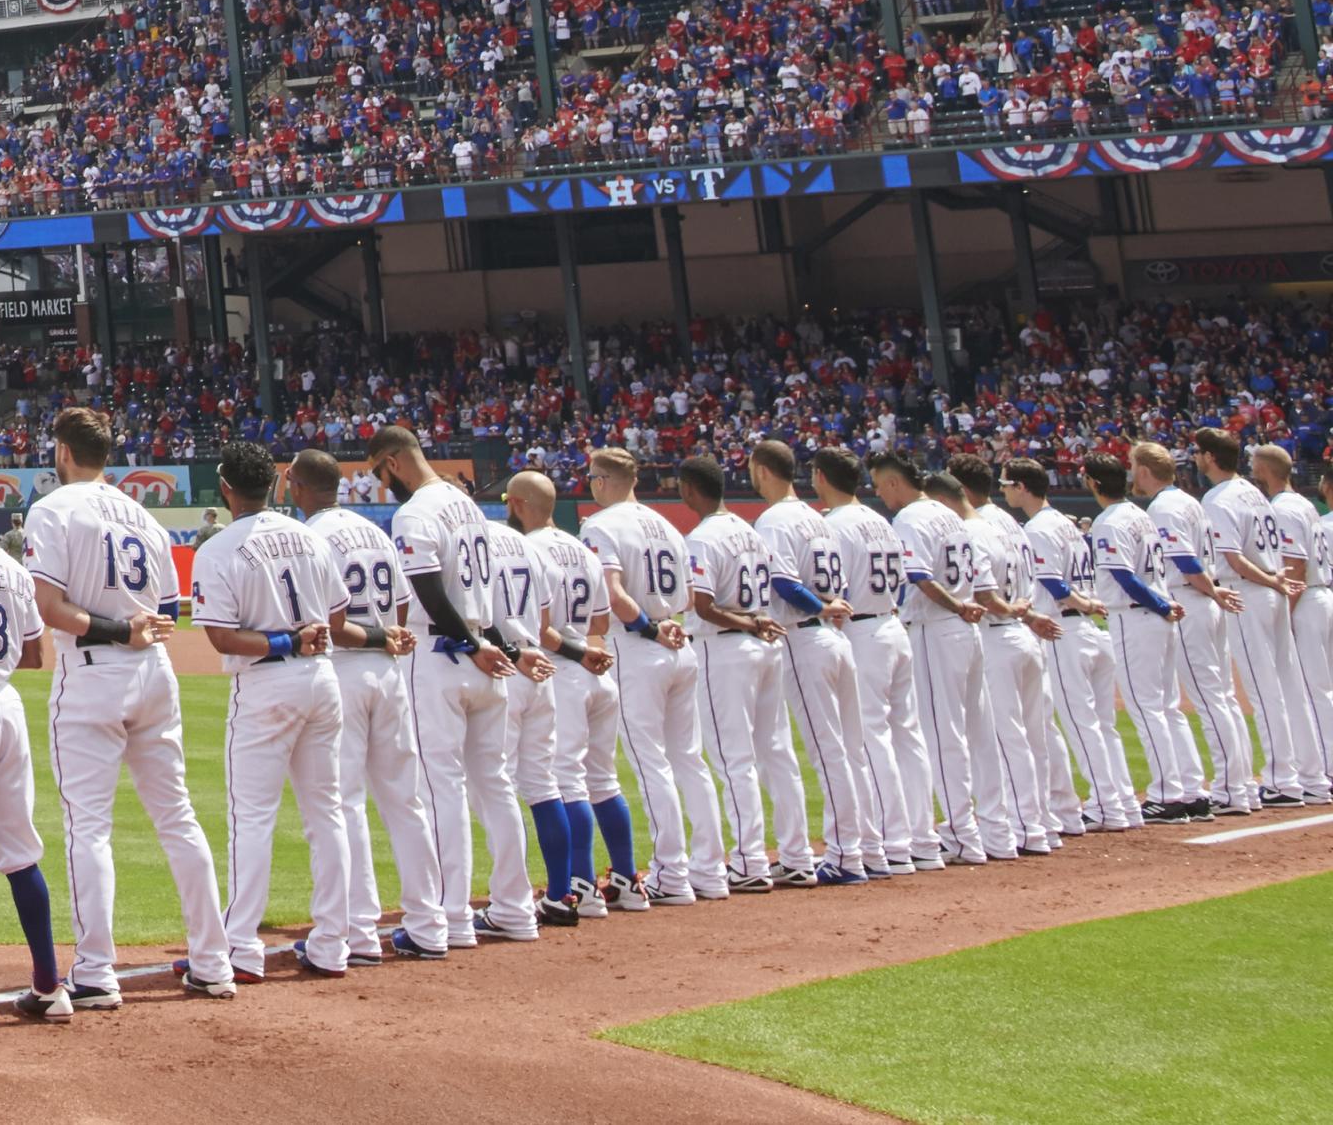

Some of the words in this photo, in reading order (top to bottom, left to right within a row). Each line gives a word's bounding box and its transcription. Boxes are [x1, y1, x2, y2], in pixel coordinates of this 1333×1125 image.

[653, 179, 675, 195] VS
[691, 168, 725, 200] T
[1186, 257, 1290, 278] TOYOTA
[32, 298, 72, 316] MARKET
[237, 532, 315, 572] ANDRUS
[1252, 514, 1279, 551] 38
[105, 531, 149, 594] 13
[458, 535, 491, 590] 30
[644, 548, 676, 596] 16
[813, 550, 842, 594] 58
[869, 551, 900, 596] 55
[944, 543, 974, 585] 53
[281, 568, 303, 624] 1
[344, 561, 394, 616] 29
[498, 568, 532, 620] 17
[562, 577, 591, 624] 12
[738, 563, 770, 609] 62
